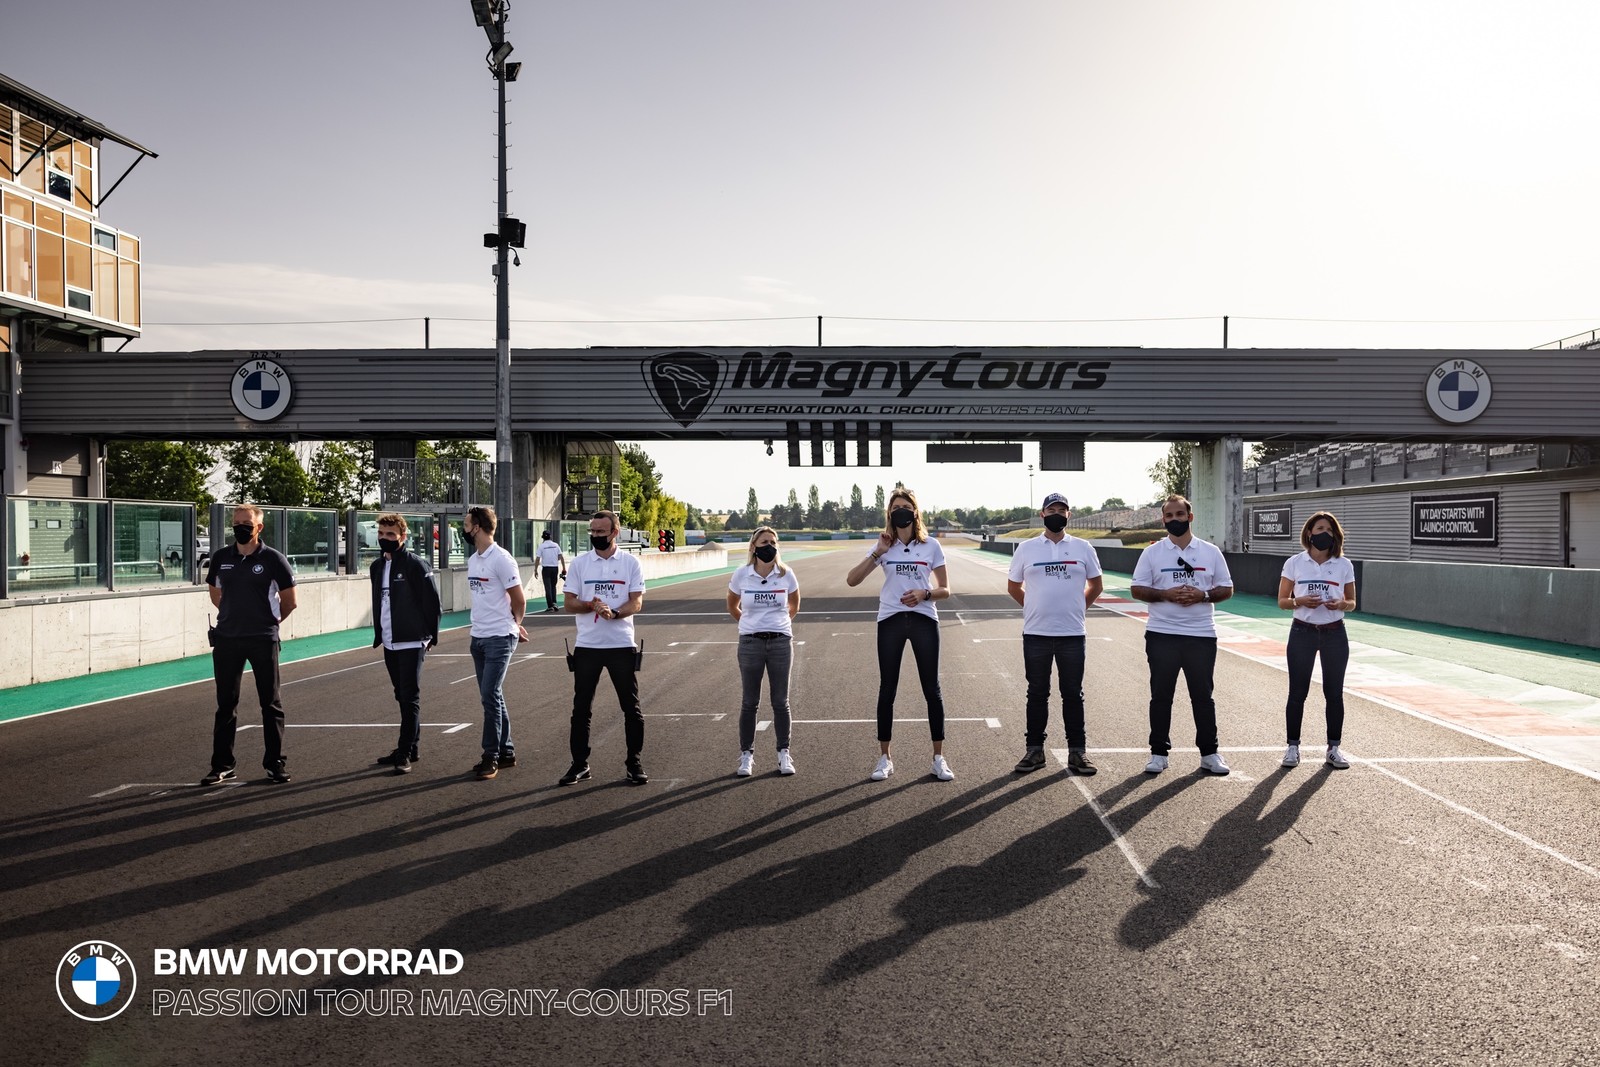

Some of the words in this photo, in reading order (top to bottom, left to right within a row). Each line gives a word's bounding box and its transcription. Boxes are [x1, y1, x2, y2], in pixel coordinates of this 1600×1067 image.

[239, 361, 284, 379] BMW
[731, 352, 1112, 397] Magny-Cours
[1434, 361, 1484, 379] BMW
[723, 405, 873, 415] INTERNATIONAL
[879, 405, 955, 415] CIRCUIT
[967, 405, 1029, 415] NEVERS
[1033, 405, 1097, 415] FRANCE
[1420, 509, 1430, 519] MY
[1430, 508, 1441, 519] DAY
[1441, 507, 1466, 519] STARTS
[1467, 506, 1485, 519] WITH
[1420, 521, 1445, 533] LAUNCH
[1445, 520, 1478, 533] CONTROL.
[1044, 564, 1067, 573] BMW
[1172, 571, 1195, 579] BMW
[594, 583, 615, 591] BMW
[1308, 583, 1330, 591] BMW
